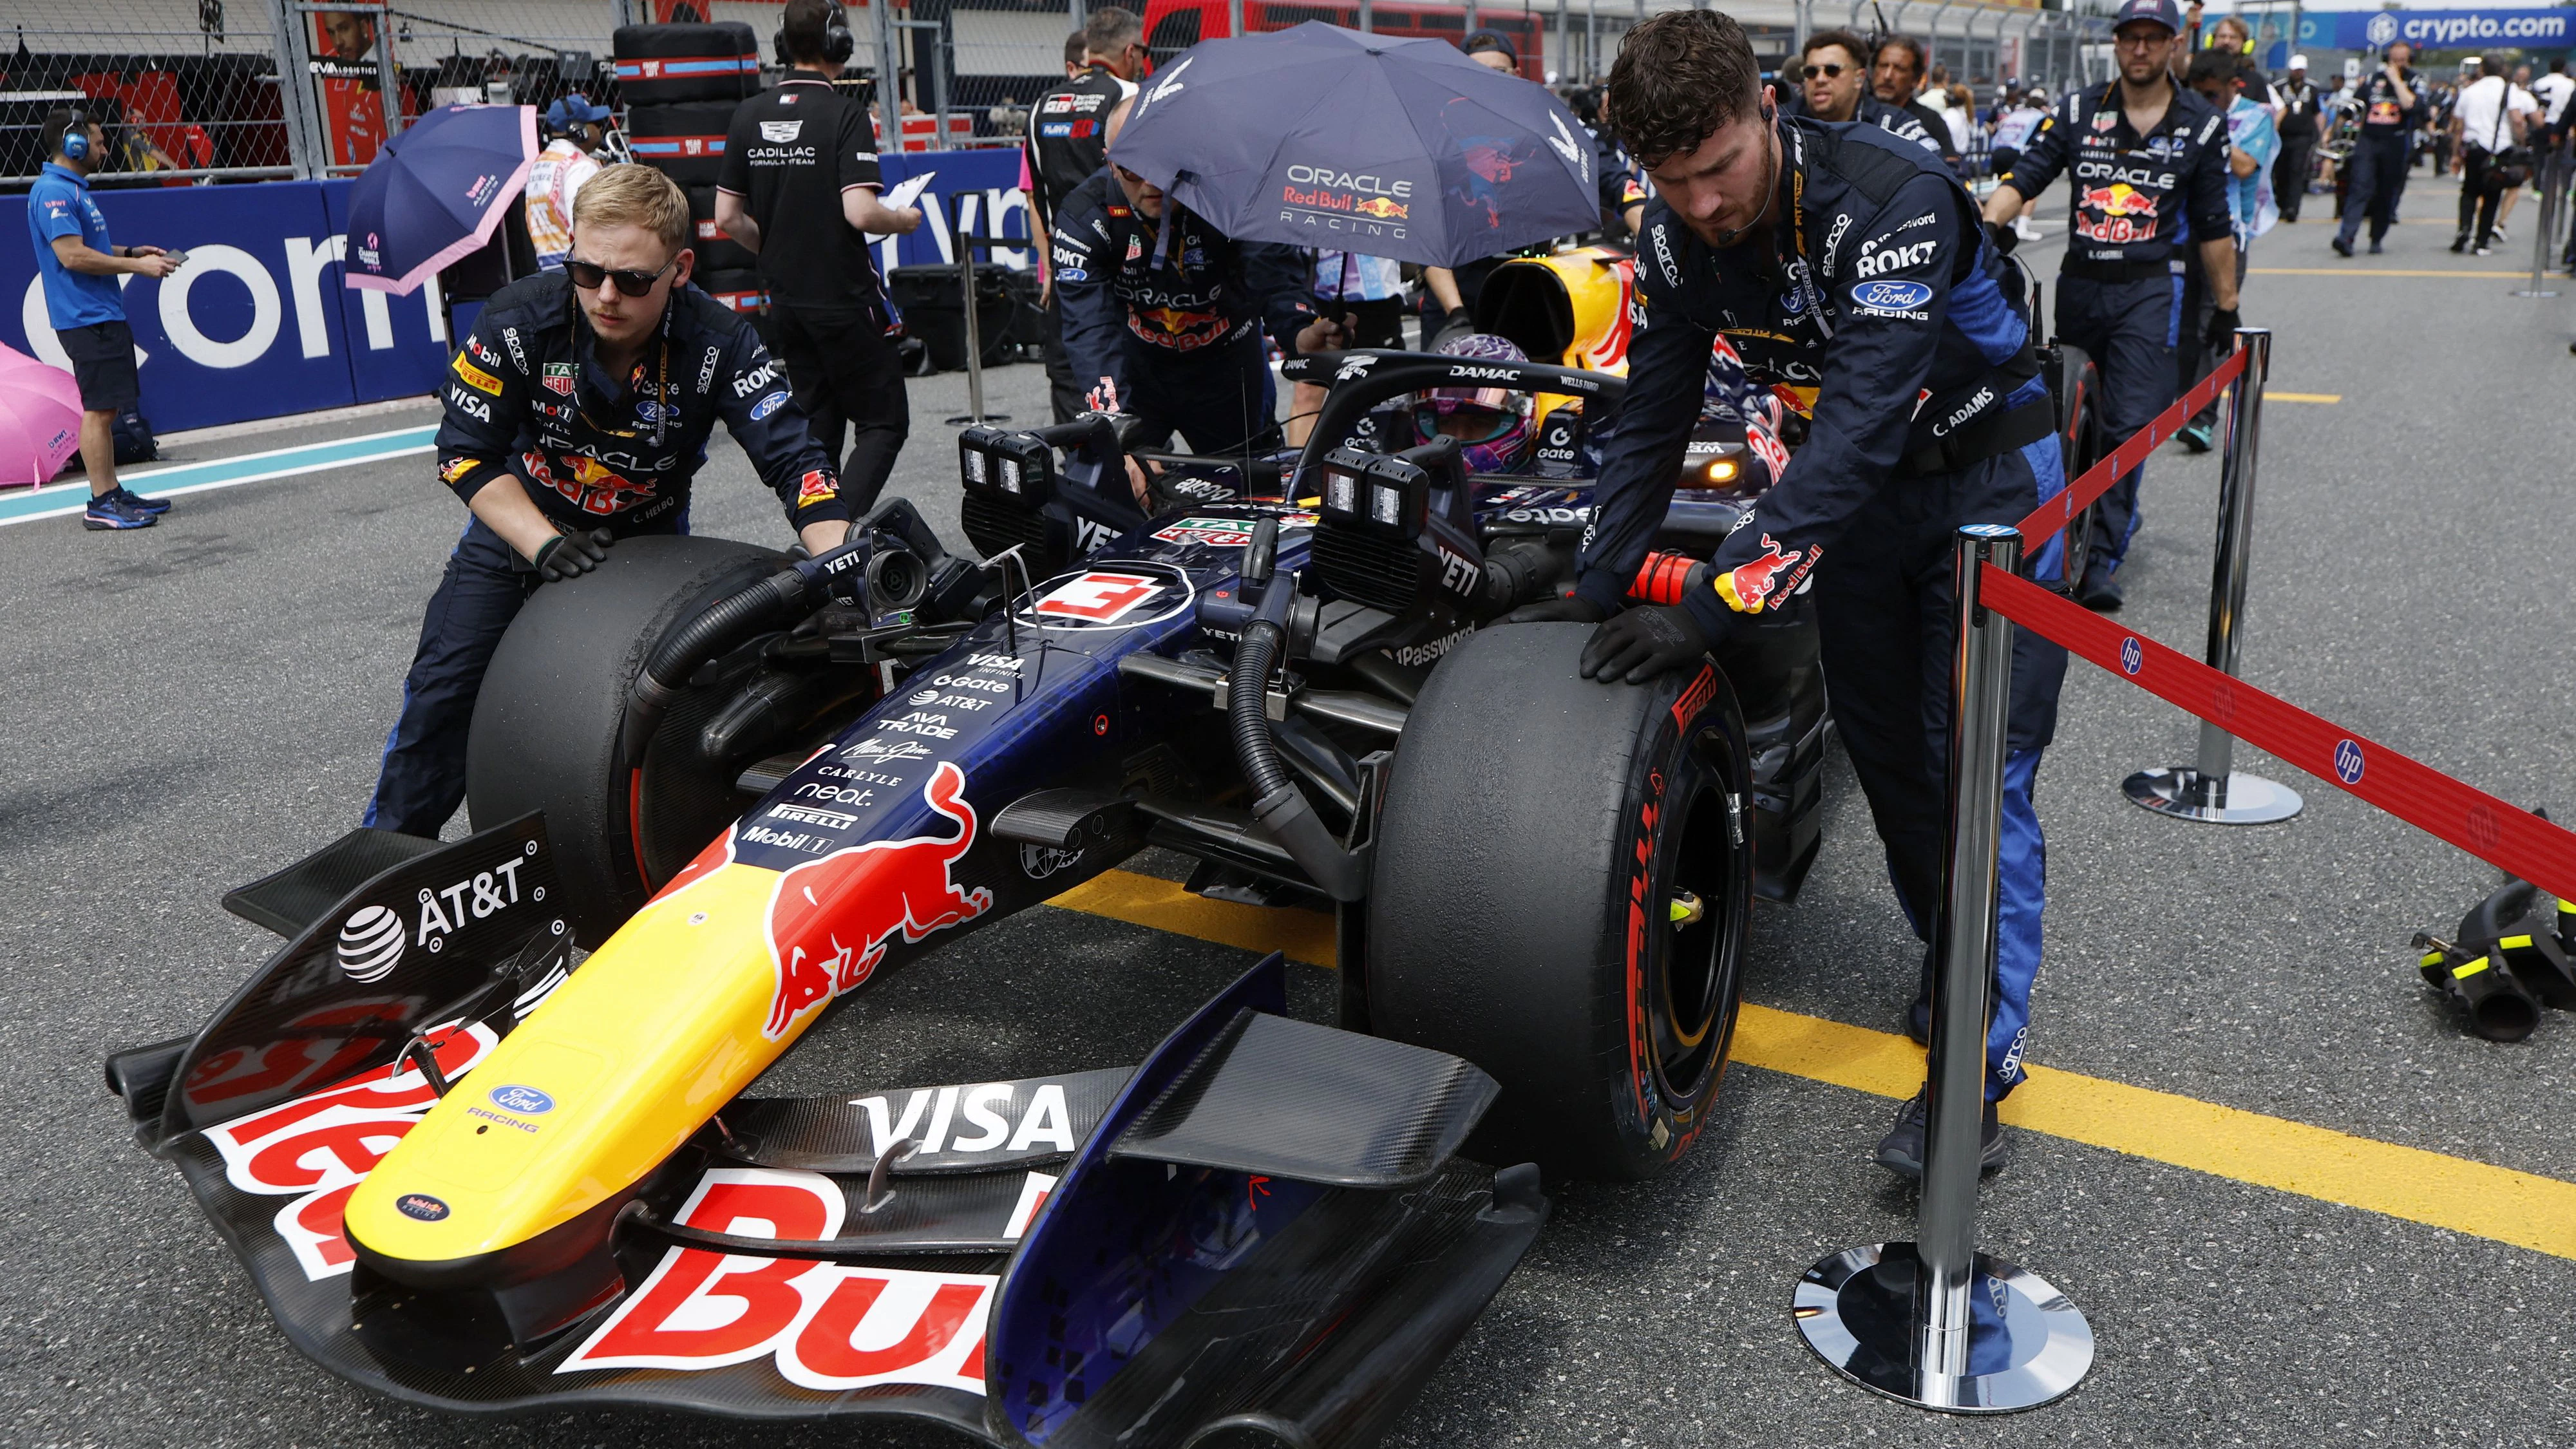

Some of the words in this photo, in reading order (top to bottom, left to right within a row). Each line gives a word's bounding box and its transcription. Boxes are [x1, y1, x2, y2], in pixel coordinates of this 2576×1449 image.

[2405, 15, 2566, 43] crypto.com
[338, 65, 377, 75] LOGISTICS
[747, 147, 815, 158] CADILLAC
[1287, 164, 1413, 198] ORACLE
[2076, 162, 2176, 189] ORACLE
[1283, 186, 1318, 205] Red
[1318, 191, 1352, 211] Bull
[1280, 211, 1406, 239] RACING
[1633, 253, 1647, 281] bil
[1856, 240, 1937, 279] ROKT
[1801, 265, 1814, 296] ACCESS
[1867, 283, 1917, 305] Ford
[1631, 301, 1649, 329] SA
[1810, 299, 1821, 317] GRID
[1852, 306, 1929, 321] RACING
[1128, 312, 1175, 348] Red
[1176, 317, 1230, 352] Bull
[466, 333, 502, 368] Mobil
[457, 355, 500, 392] PIRELLI
[697, 346, 720, 395] sparco
[732, 361, 779, 398] ROK
[1449, 365, 1521, 381] DAMAC
[1560, 375, 1584, 387] WELLS
[545, 378, 573, 394] HEU
[451, 381, 491, 423] VISA
[1933, 423, 1949, 437] C.
[1949, 386, 1994, 428] ADAMS
[1537, 448, 1575, 460] Gate
[645, 495, 675, 520] HELBO
[1202, 504, 1321, 515] ORACL
[824, 551, 861, 574] YETI
[1439, 545, 1480, 597] YETI
[1767, 576, 1799, 611] Red
[1794, 544, 1824, 580] Bull
[835, 596, 854, 607] YET
[1202, 627, 1242, 643] YETI
[967, 653, 1025, 671] VISA
[2123, 639, 2141, 674] hp
[951, 677, 1010, 693] Gate
[978, 667, 1026, 679] INFINITE
[935, 695, 994, 711] AT&T
[1671, 663, 1717, 738] PIRELLI
[877, 720, 958, 740] TRADE
[901, 712, 947, 726] AVA
[840, 738, 889, 757] Maui
[875, 741, 934, 764] Jim
[2336, 741, 2362, 783] hp
[817, 766, 903, 788] CARLYLE
[793, 782, 875, 807] neat.
[766, 802, 858, 830] PIRELLI
[741, 826, 810, 849] Mobil
[417, 857, 525, 947] AT&T
[498, 1088, 545, 1112] Ford
[466, 1106, 540, 1133] RACING
[848, 1083, 1075, 1159] VISA
[402, 1204, 438, 1220] RACING
